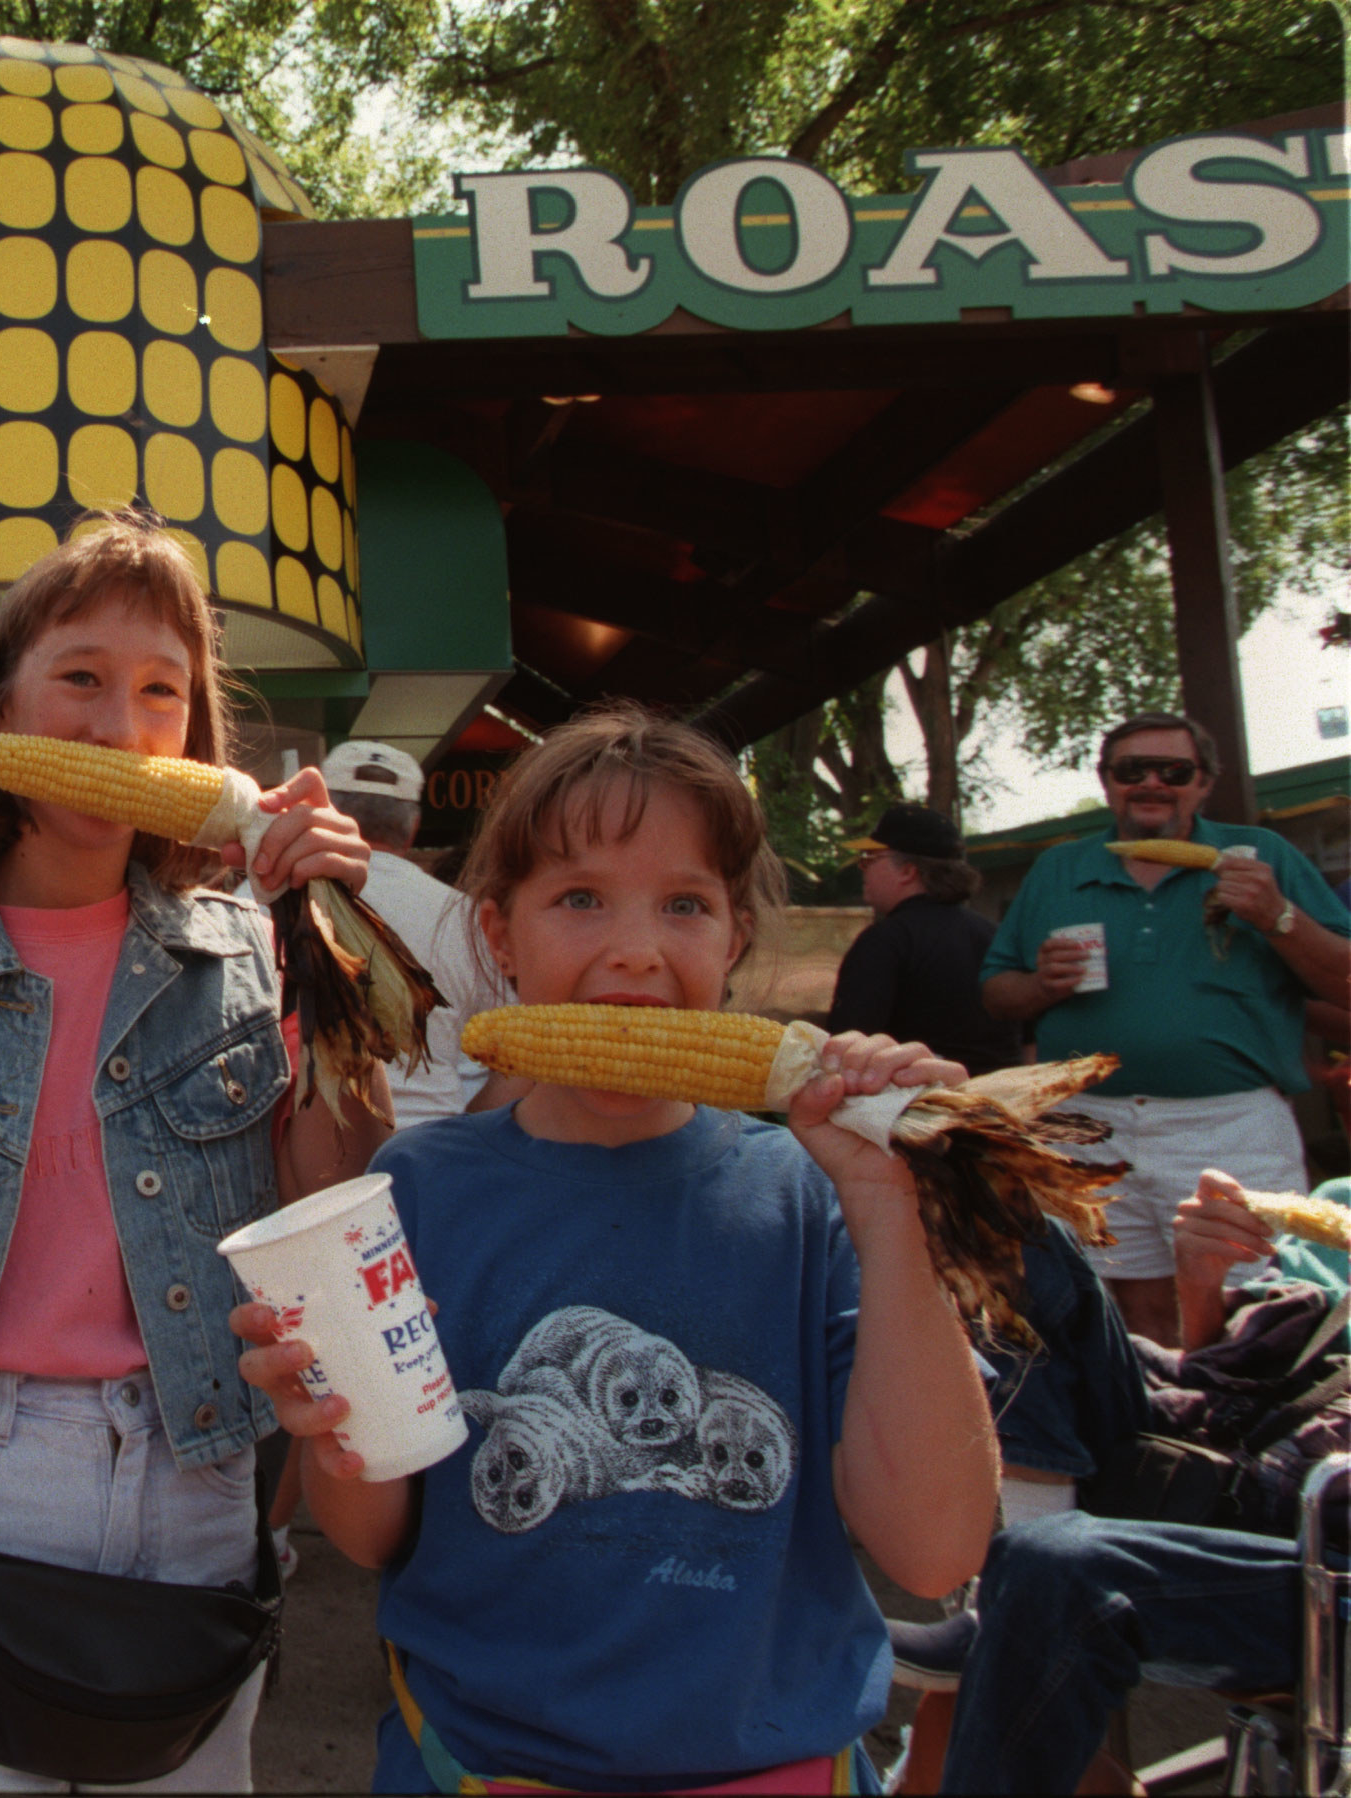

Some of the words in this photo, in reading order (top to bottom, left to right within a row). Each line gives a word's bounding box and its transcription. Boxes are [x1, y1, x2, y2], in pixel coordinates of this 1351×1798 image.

[393, 1353, 425, 1375] Keep
[417, 1398, 437, 1415] cup
[643, 1555, 738, 1592] Alaska
